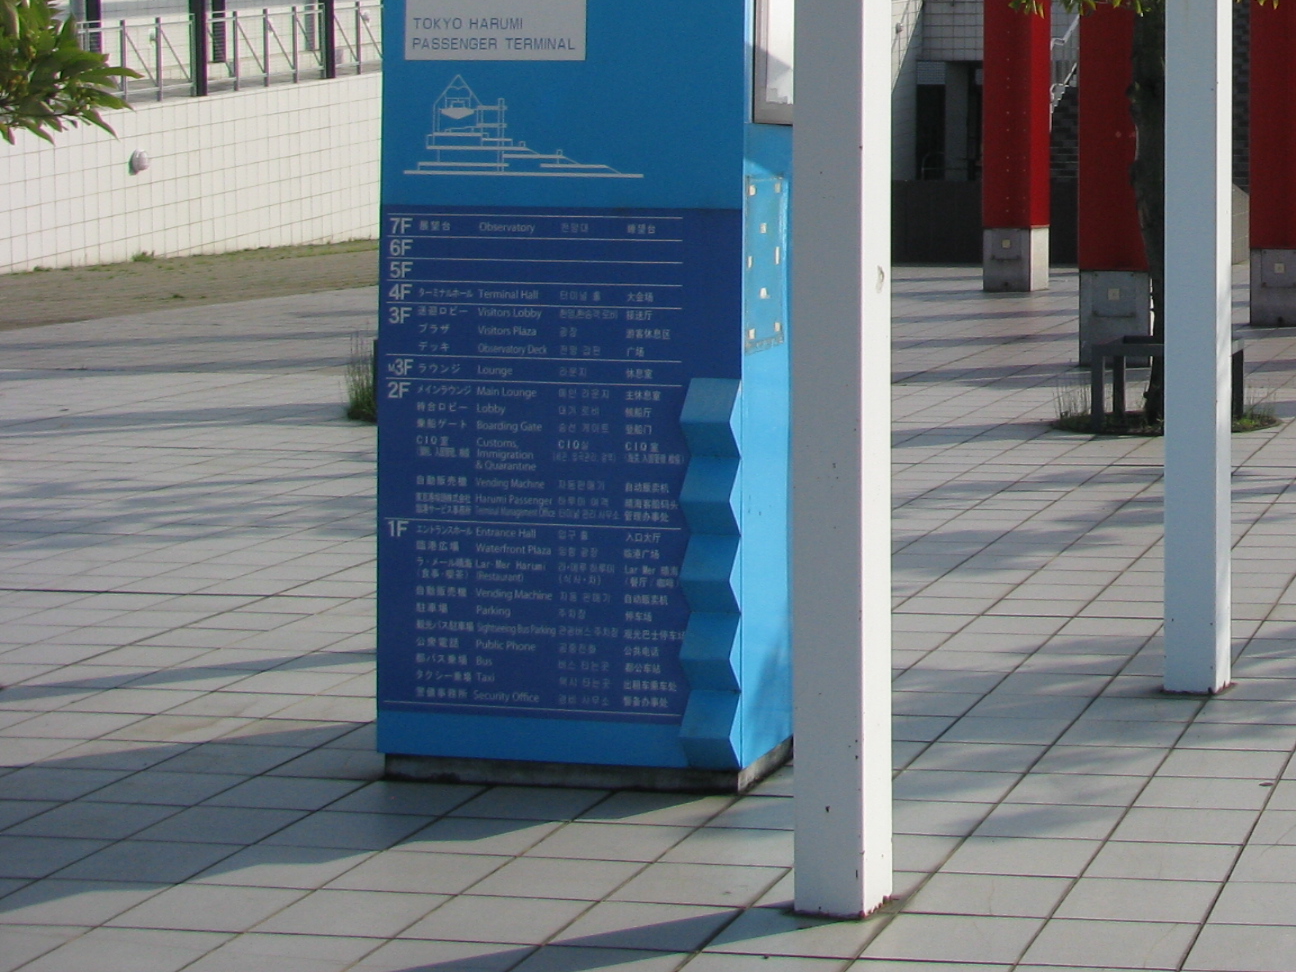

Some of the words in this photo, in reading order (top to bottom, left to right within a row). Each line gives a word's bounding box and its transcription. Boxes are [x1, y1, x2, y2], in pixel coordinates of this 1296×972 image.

[413, 17, 463, 31] TOKYO
[469, 17, 523, 31] HARUMI
[412, 37, 498, 51] PASSENGER
[505, 37, 576, 51] TERMINAL
[389, 217, 413, 234] 7F
[478, 221, 535, 234] Observatory
[389, 239, 413, 256] 6F
[389, 261, 413, 278] 5F
[388, 283, 413, 300] 4F
[478, 288, 518, 299] Terminal
[521, 289, 539, 300] Hall
[388, 307, 412, 324] 3F
[477, 307, 511, 318] Visitors
[513, 308, 542, 320] Lobby
[419, 323, 450, 334] プラザ
[478, 325, 511, 335] Visitors
[513, 325, 537, 336] Plaza
[418, 341, 449, 352] デッキ
[477, 343, 525, 356] Observatory
[527, 344, 547, 355] Deck
[418, 362, 460, 374] ラウンジ
[477, 364, 513, 377] Lounge
[387, 381, 411, 398] 2F
[416, 385, 471, 395] メインラウンジ
[476, 386, 500, 396] Main
[502, 387, 538, 399] Lounge
[476, 403, 506, 416] Lobby
[476, 419, 519, 433] Boarding
[520, 421, 543, 432] Gate
[476, 437, 519, 449] Customs,
[476, 448, 534, 461] Immigration
[484, 460, 537, 471] Quarantine
[474, 477, 509, 490] Vending
[510, 478, 545, 490] Machine
[474, 494, 507, 504] Harumi
[508, 494, 553, 506] Passenger
[387, 520, 409, 537] 1F
[416, 525, 472, 536] エントランスホール
[475, 527, 516, 538] Entrance
[518, 528, 536, 539] Hall
[475, 543, 526, 554] Waterfront
[527, 544, 552, 555] Plaza
[515, 561, 546, 571] Harumi
[475, 587, 512, 601] Vending
[514, 589, 553, 601] Machine
[476, 604, 511, 618] Parking
[530, 624, 557, 637] Parking
[475, 639, 504, 650] Public
[506, 640, 536, 651] Phone
[476, 655, 492, 666] Bus
[476, 672, 495, 683] Taxi
[473, 689, 510, 703] Security
[512, 691, 540, 703] Office
